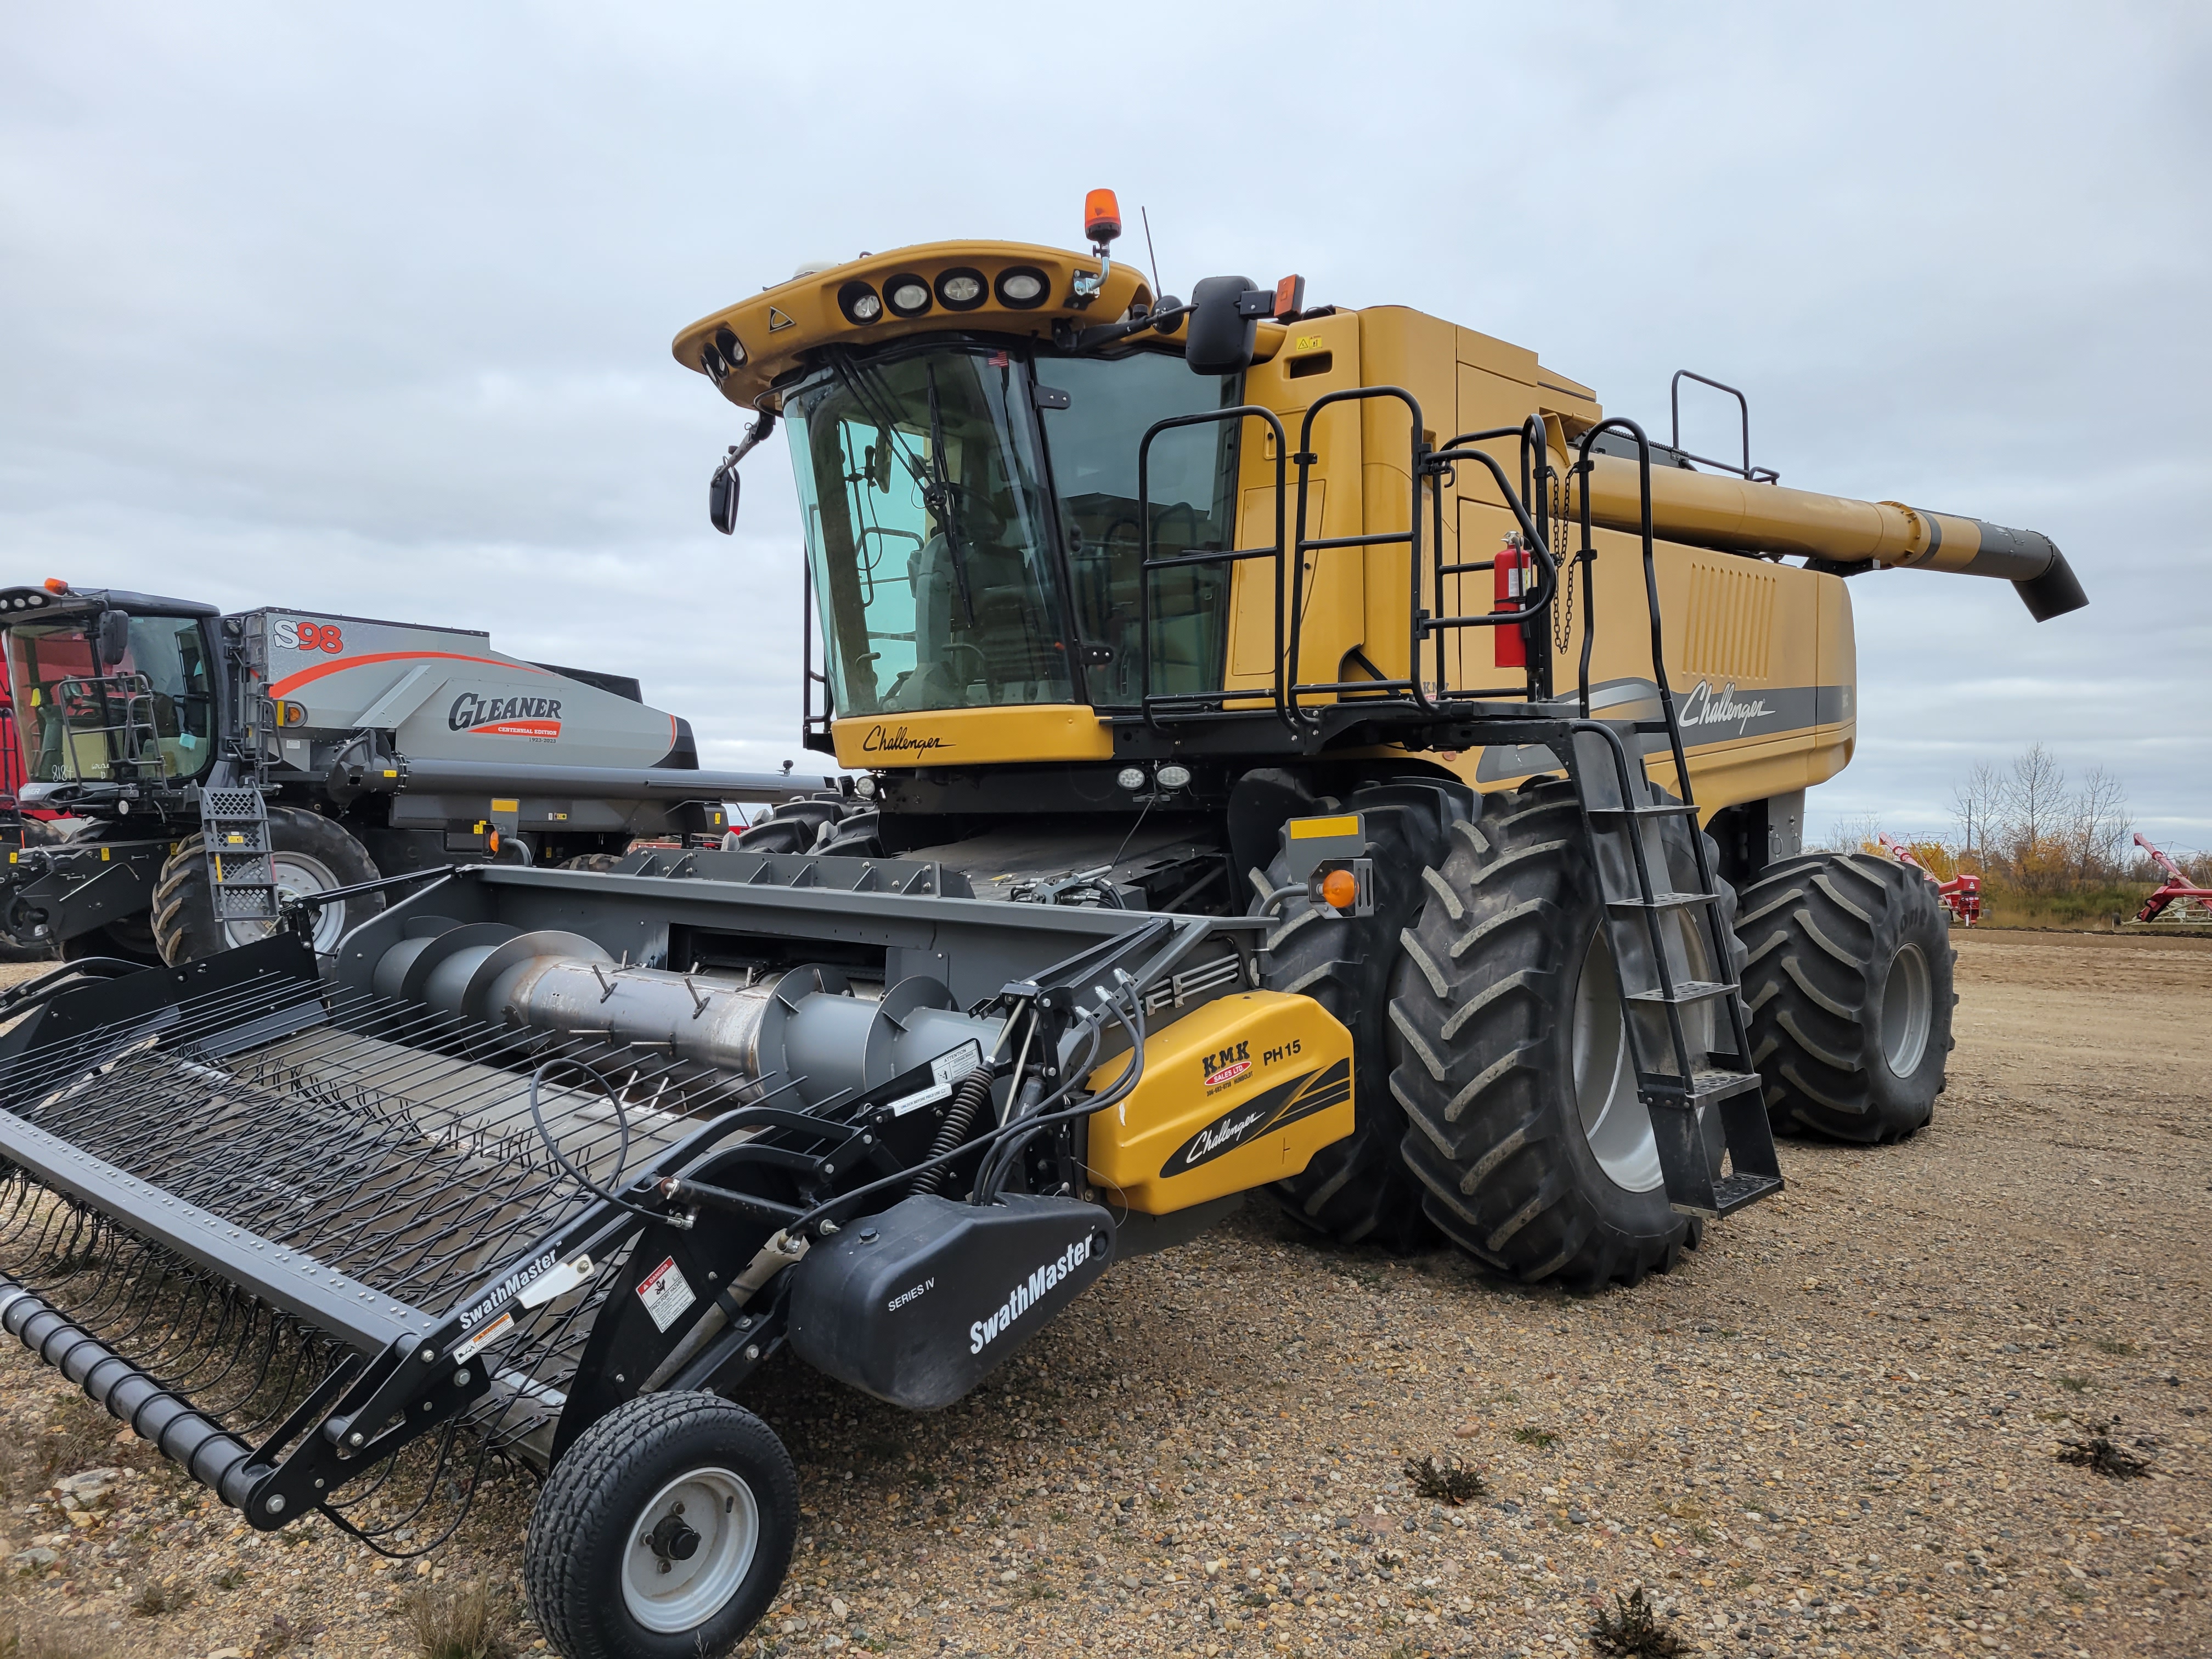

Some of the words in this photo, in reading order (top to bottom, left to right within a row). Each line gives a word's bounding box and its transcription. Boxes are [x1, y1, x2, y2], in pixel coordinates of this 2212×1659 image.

[273, 619, 344, 654] S98
[448, 692, 562, 731] GLEANER
[1679, 680, 1776, 735] Challenger
[863, 725, 957, 759] Challenger
[944, 1048, 967, 1063] ATTENTION
[1202, 1040, 1250, 1078] K.M.K
[1263, 1046, 1283, 1066] PH
[1285, 1039, 1301, 1057] 15
[1214, 1069, 1233, 1083] SALES
[1233, 1065, 1245, 1075] LTD.
[1186, 1111, 1266, 1164] Challenger
[459, 1249, 556, 1330] SwathMaster
[648, 1263, 669, 1284] DANGER
[888, 1284, 924, 1312] SERIES
[925, 1277, 934, 1290] IV
[970, 1233, 1093, 1355] SwathMaster
